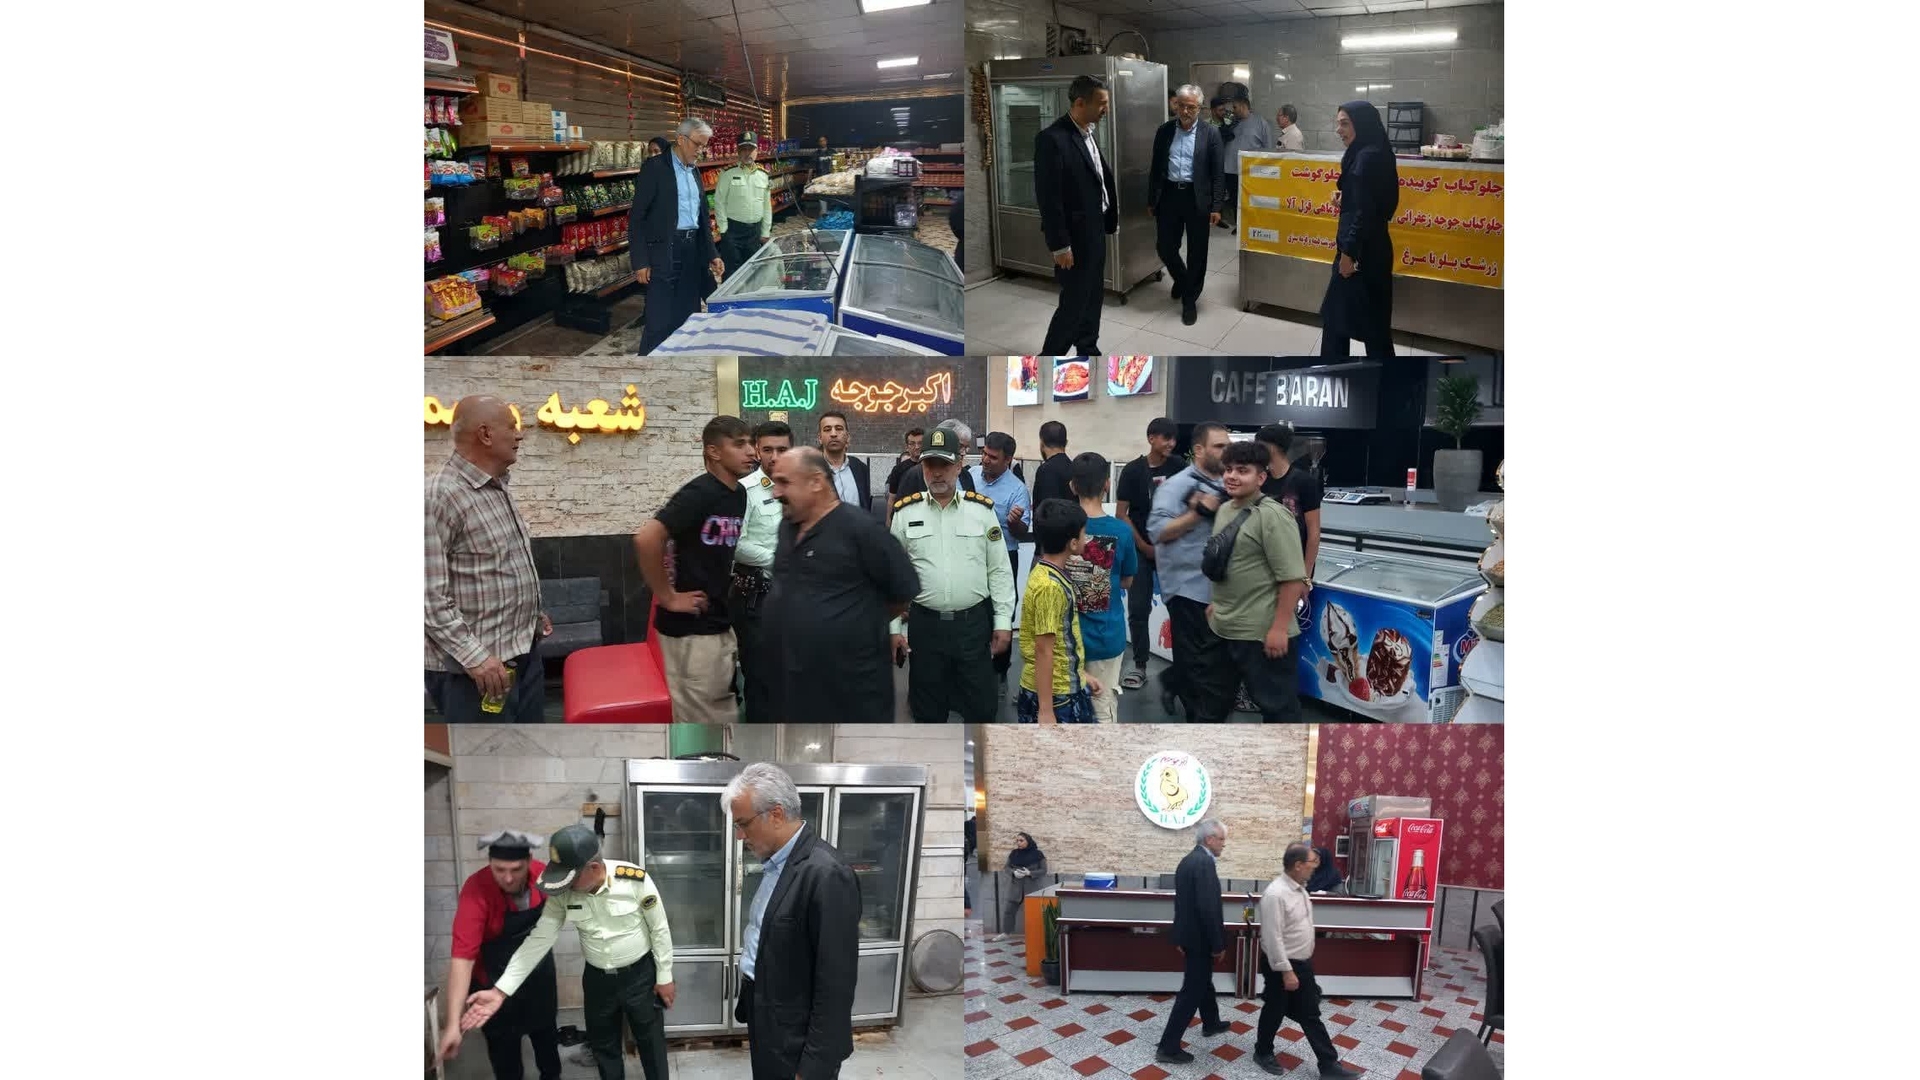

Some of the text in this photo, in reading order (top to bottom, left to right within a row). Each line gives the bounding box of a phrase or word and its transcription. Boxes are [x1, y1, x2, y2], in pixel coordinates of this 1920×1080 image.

[742, 379, 818, 409] H.A.J
[1211, 370, 1349, 408] CAFE BARAN
[536, 383, 646, 445] شعبه
